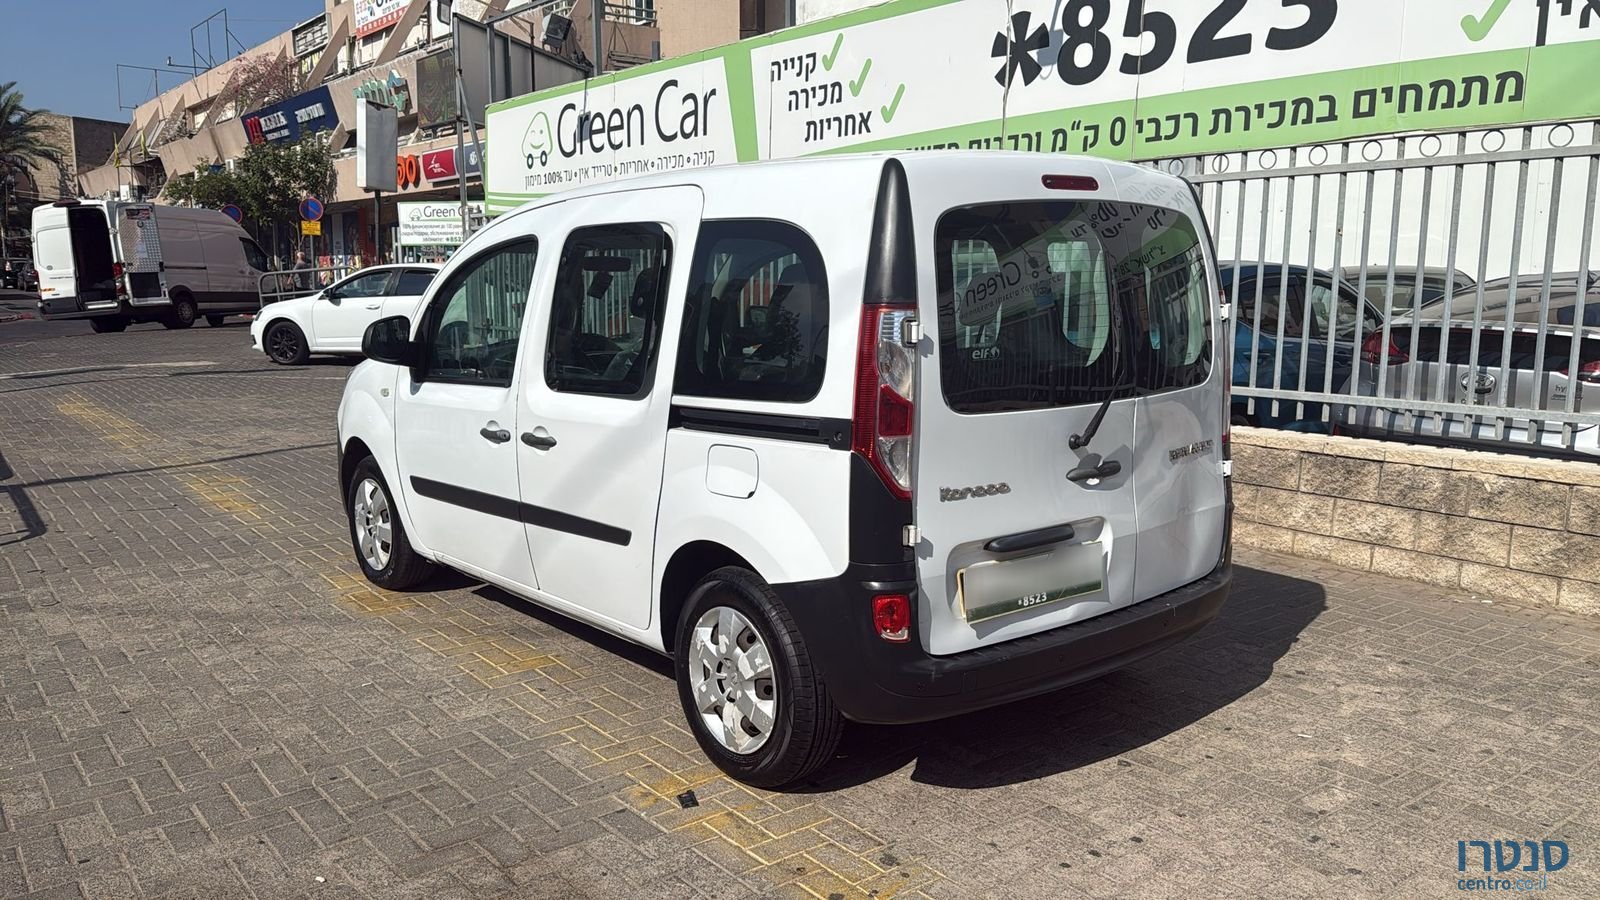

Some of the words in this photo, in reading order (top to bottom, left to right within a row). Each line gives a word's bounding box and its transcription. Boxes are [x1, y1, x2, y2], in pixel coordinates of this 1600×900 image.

[771, 52, 817, 82] קנייה
[788, 81, 843, 111] מכירה
[1352, 70, 1525, 120] מתמחים
[557, 103, 645, 158] Green
[654, 79, 717, 143] Car
[1209, 94, 1338, 135] במכירת
[804, 111, 872, 142] אחריות
[1110, 116, 1126, 147] 0
[1136, 112, 1199, 143] רכבי
[619, 159, 649, 176] אחריות
[656, 154, 685, 169] מכירה
[692, 150, 715, 167] קניה
[525, 173, 542, 190] מימון
[543, 170, 563, 185] 100%
[563, 169, 573, 182] עד
[423, 205, 456, 218] Green
[972, 348, 990, 360] elf
